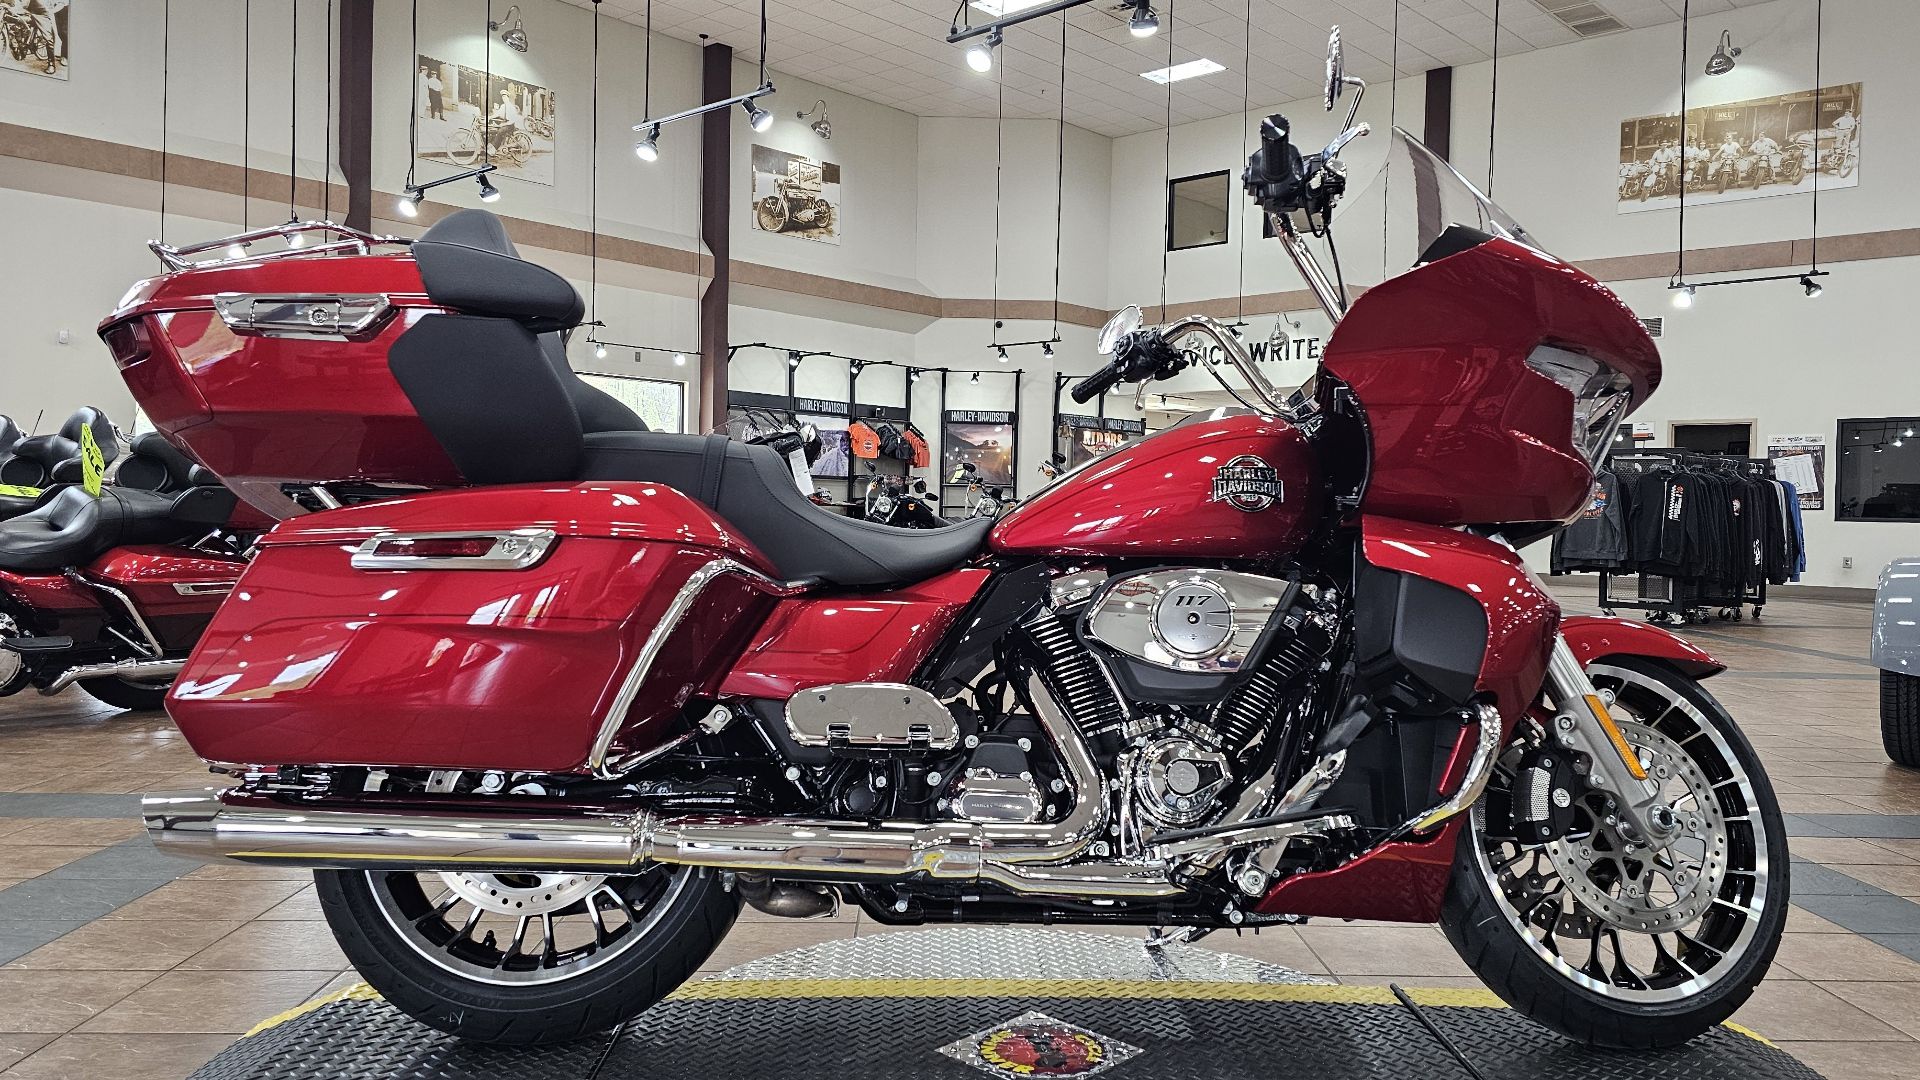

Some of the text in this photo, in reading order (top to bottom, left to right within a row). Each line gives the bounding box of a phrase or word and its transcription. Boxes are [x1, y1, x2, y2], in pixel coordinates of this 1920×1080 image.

[799, 398, 848, 414] HARLEY-DAVIDSON
[951, 411, 1009, 422] HARLEY-DAVIDSON
[1217, 480, 1281, 498] DAVIDSON
[1175, 595, 1212, 606] 117
